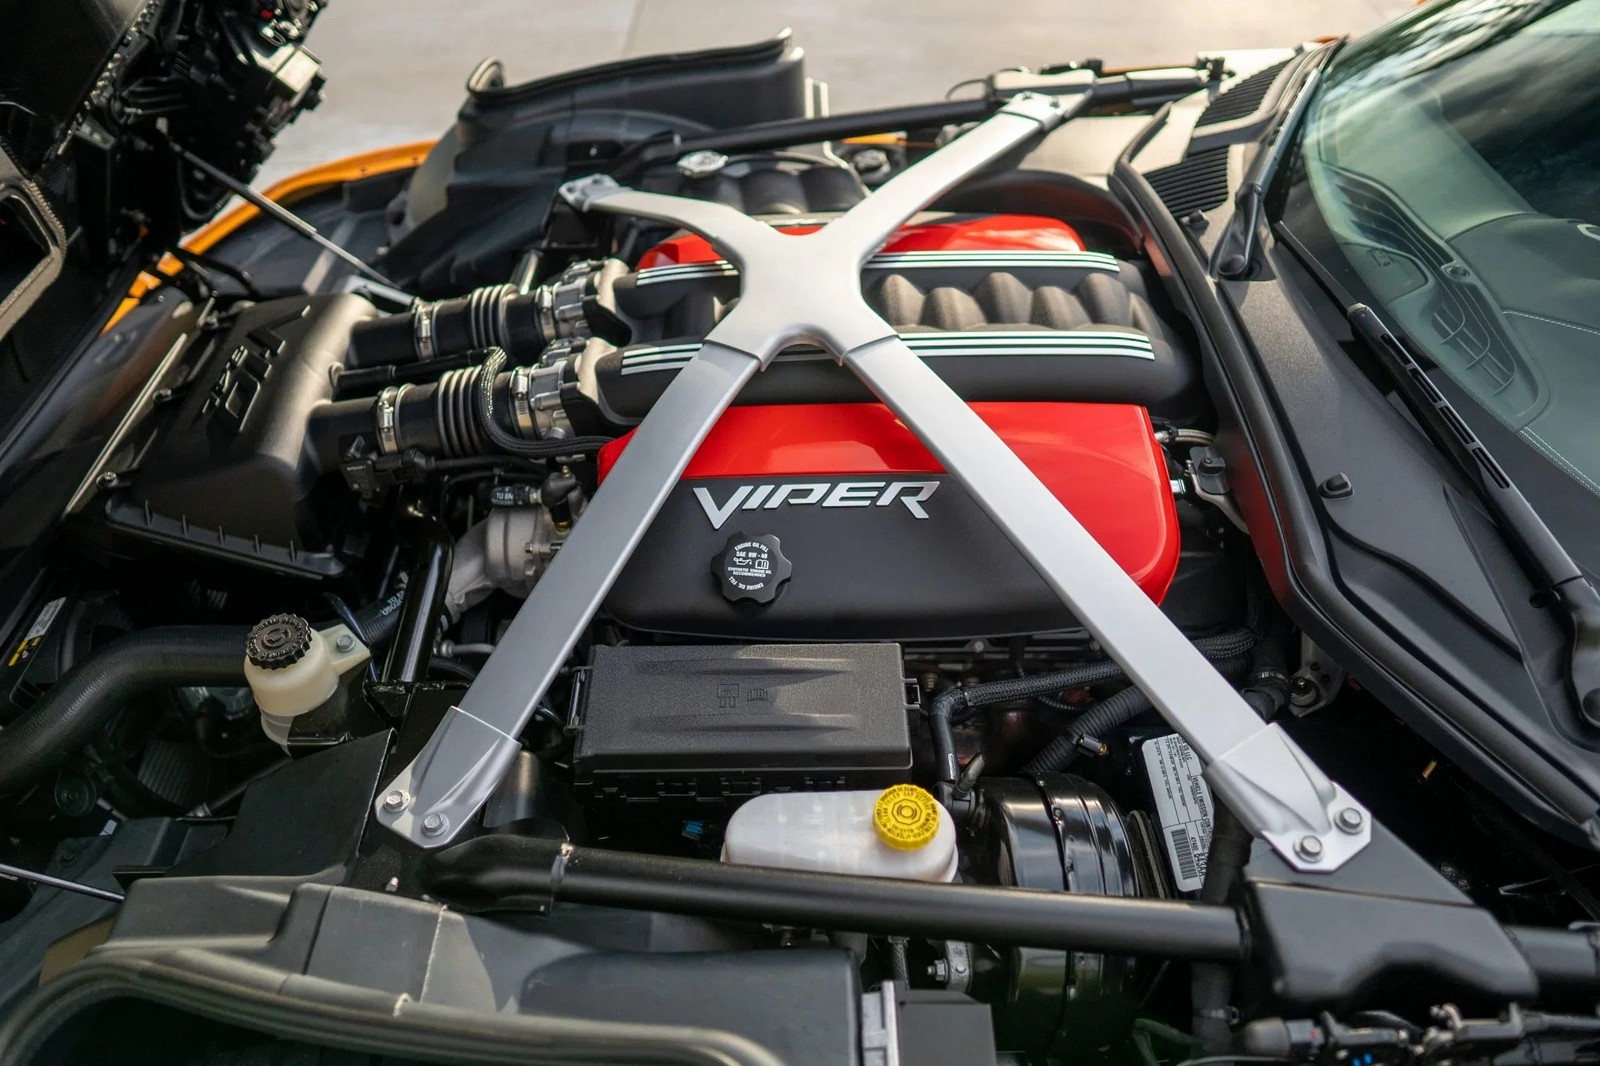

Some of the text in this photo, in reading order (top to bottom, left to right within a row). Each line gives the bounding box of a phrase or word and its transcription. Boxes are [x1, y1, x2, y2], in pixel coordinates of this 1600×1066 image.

[692, 481, 941, 530] VIPER
[734, 542, 751, 550] ENGINE
[760, 544, 769, 552] FILL
[729, 576, 738, 585] FILL
[738, 582, 746, 590] OIL
[1191, 776, 1202, 796] VEHICLE
[1197, 794, 1208, 817] EMISSION
